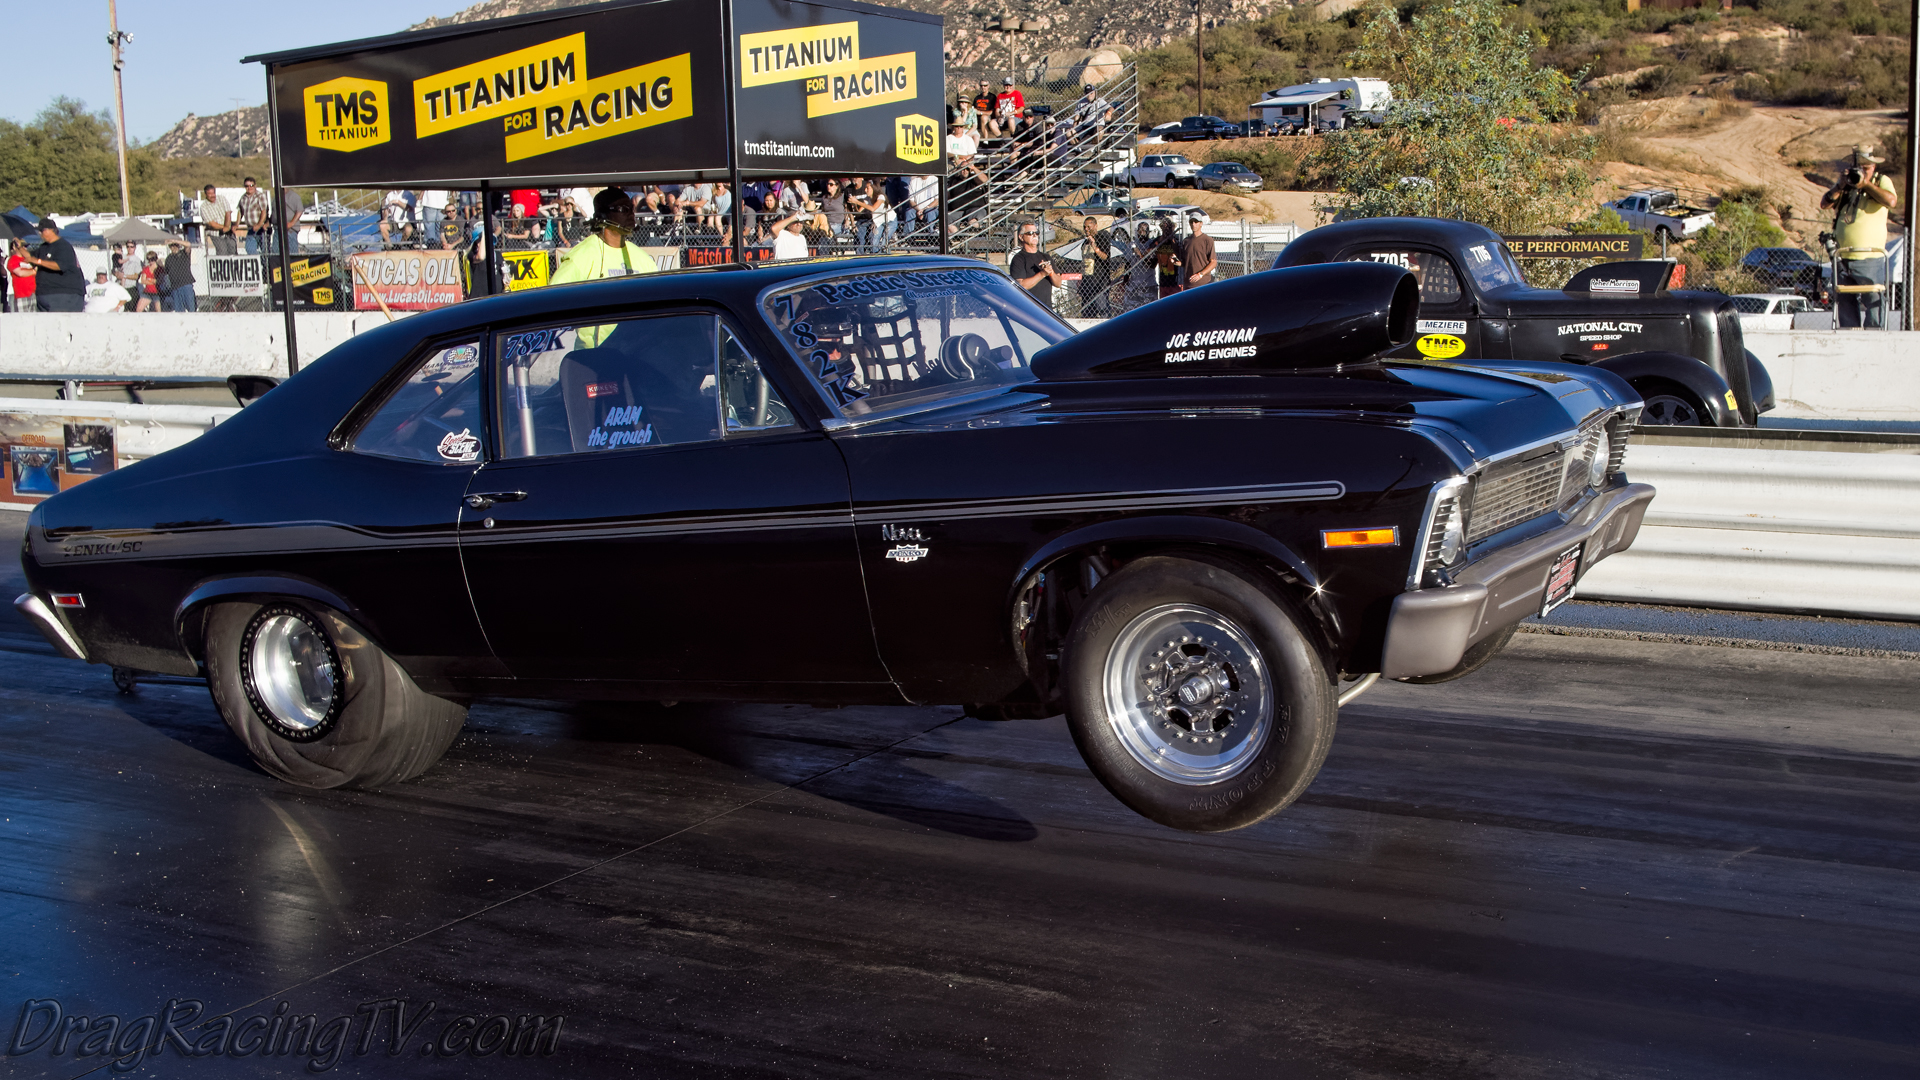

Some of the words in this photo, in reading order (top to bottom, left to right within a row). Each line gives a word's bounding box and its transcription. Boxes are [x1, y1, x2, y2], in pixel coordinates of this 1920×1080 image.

[748, 35, 853, 76] TITANIUM
[423, 52, 576, 122] TITANIUM
[806, 77, 826, 93] FOR
[832, 66, 907, 102] RACING
[314, 89, 379, 127] TMS
[504, 111, 533, 132] FOR
[544, 76, 674, 140] RACING
[318, 126, 379, 141] TITANIUM
[901, 123, 934, 148] TMS
[744, 139, 836, 158] tmstitanium.com
[903, 147, 934, 156] TITANIUM
[688, 248, 723, 265] Match
[725, 248, 754, 263] Re
[1527, 240, 1630, 253] PERFORMANCE
[209, 257, 260, 282] CROWER
[300, 267, 328, 281] RACING
[355, 258, 421, 286] LUCAS
[424, 258, 457, 285] OIL
[315, 291, 331, 300] TMS
[812, 272, 908, 305] Pacific
[900, 268, 966, 289] Street
[1425, 321, 1465, 329] MEZIERE
[1557, 321, 1618, 336] NATIONAL
[1618, 321, 1644, 334] CITY
[505, 326, 576, 359] 782K
[1166, 333, 1191, 349] JOE
[1192, 326, 1257, 347] SHERMAN
[1423, 338, 1460, 350] TMS
[1579, 334, 1603, 342] SPEED
[1164, 349, 1206, 363] RACING
[1208, 345, 1257, 360] ENGINES
[604, 405, 643, 427] ARAM
[587, 426, 607, 446] the
[607, 423, 653, 449] grouch
[448, 441, 477, 454] SCENE
